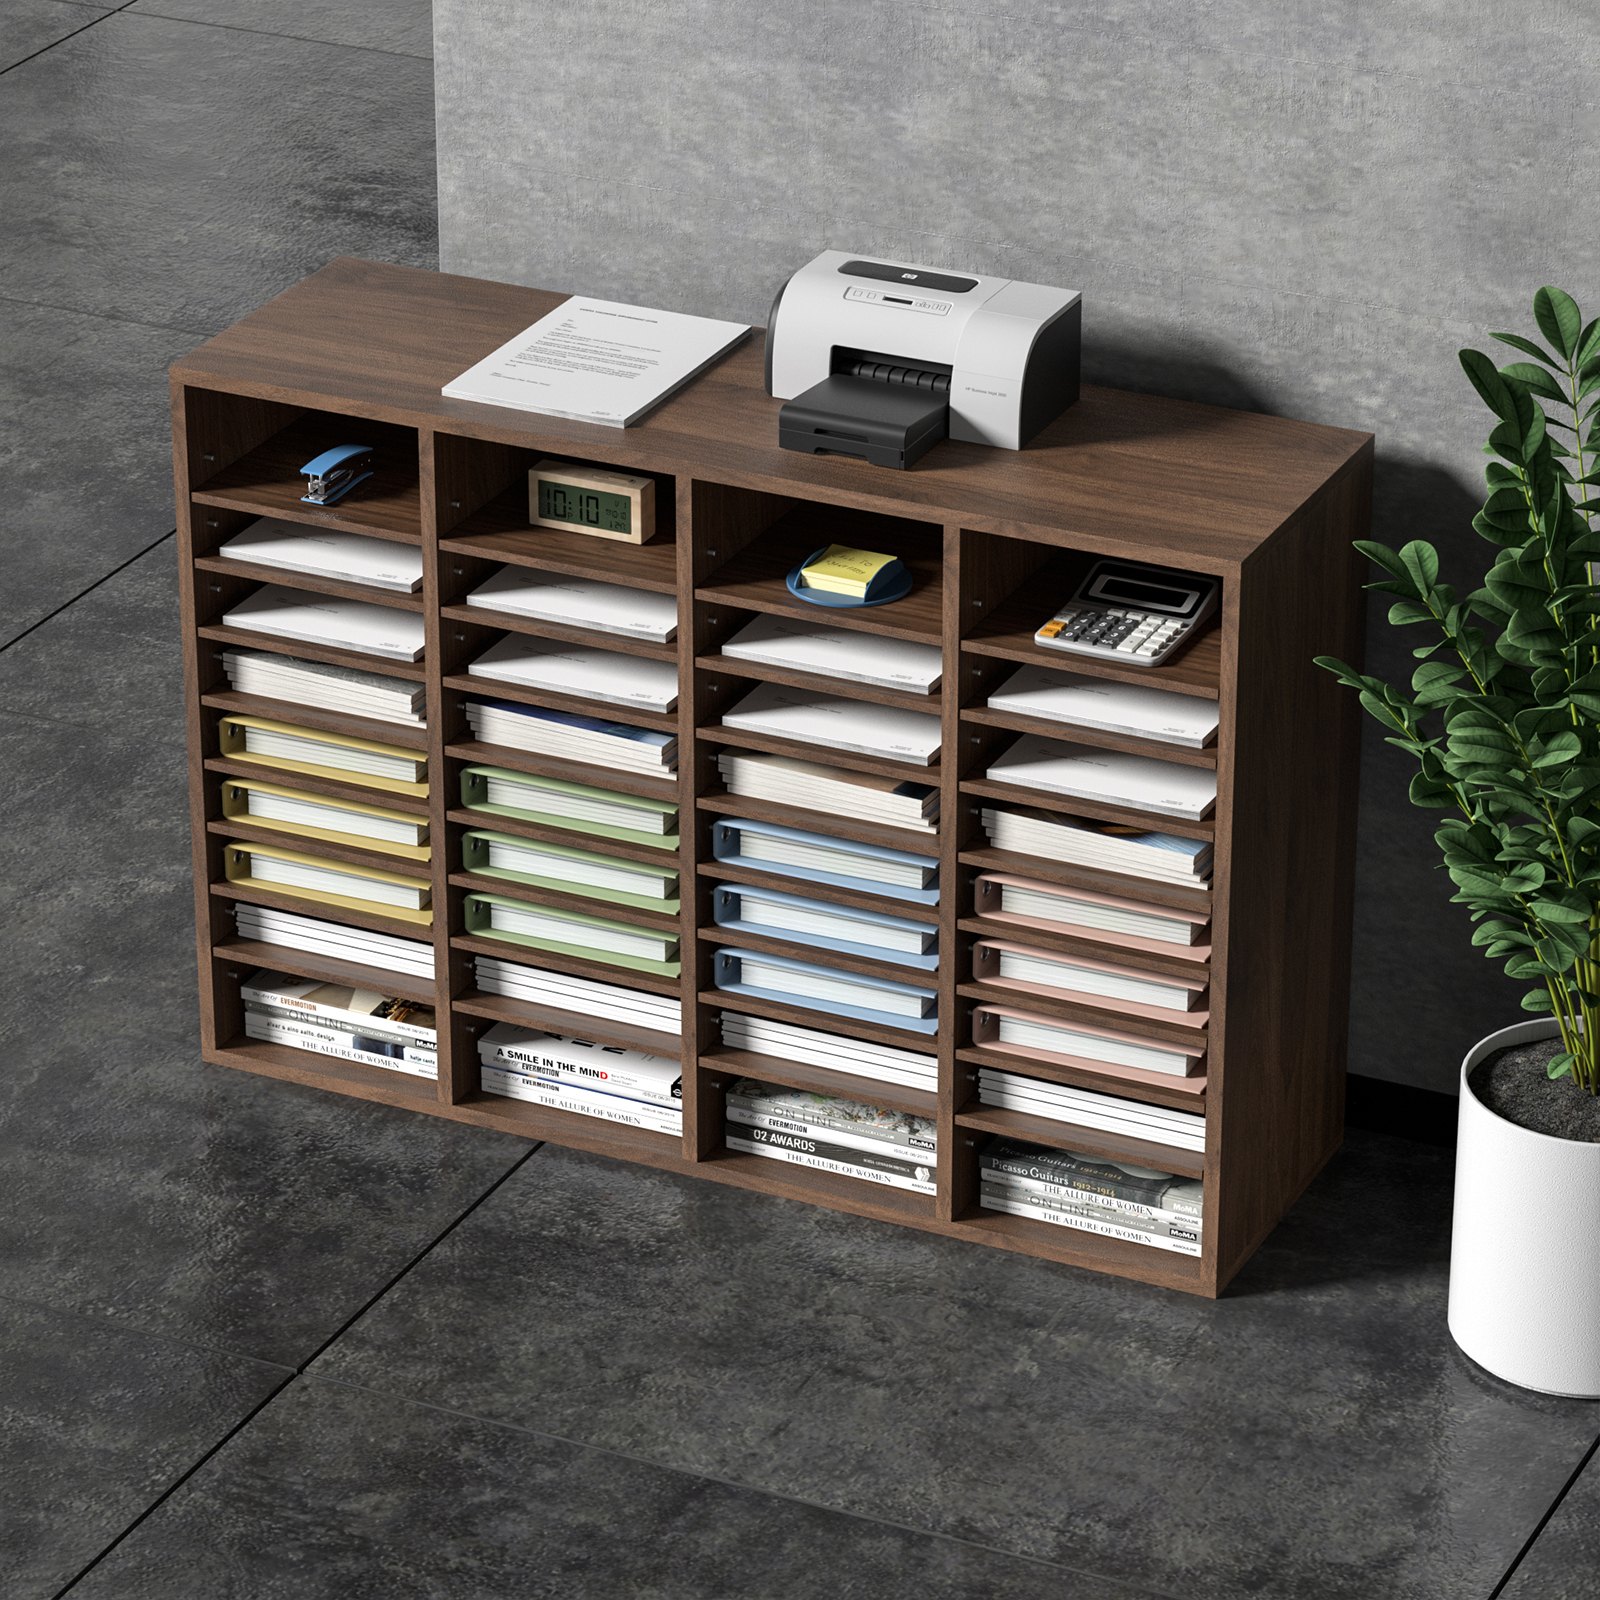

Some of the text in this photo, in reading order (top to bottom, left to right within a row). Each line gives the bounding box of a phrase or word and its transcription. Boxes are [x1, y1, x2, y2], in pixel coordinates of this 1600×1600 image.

[547, 488, 599, 525] 10:10
[280, 997, 317, 1011] EVERMOTION
[288, 1009, 309, 1022] ON
[316, 1015, 349, 1032] LINE
[316, 1033, 335, 1042] design
[302, 1041, 400, 1068] THE ALLURE OF WOMEN
[497, 1048, 504, 1057] A
[507, 1050, 539, 1064] SMILE
[543, 1059, 553, 1068] IN
[557, 1061, 576, 1073] THE
[579, 1067, 608, 1080] MIND
[521, 1063, 560, 1078] EVERMOTION
[522, 1078, 560, 1092] EVERMOTION
[540, 1095, 641, 1125] THE ALLURE OF WOMEN
[774, 1106, 795, 1119] ON
[803, 1110, 837, 1127] LINE
[768, 1118, 808, 1133] EVERMOTION
[769, 1133, 816, 1152] AWARDS
[909, 1138, 934, 1150] MoMA
[786, 1152, 804, 1163] THE
[806, 1157, 841, 1171] ALLURE
[842, 1164, 855, 1173] OF
[856, 1168, 891, 1183] WOMEN
[992, 1158, 1028, 1176] Picasso
[1029, 1167, 1069, 1185] Guitars
[1038, 1155, 1077, 1169] Guitars
[1029, 1195, 1052, 1208] ON
[1060, 1202, 1095, 1218] LINE
[1043, 1184, 1062, 1195] THE
[1063, 1189, 1100, 1203] ALLURE
[1102, 1198, 1114, 1207] OF
[1116, 1201, 1153, 1216] WOMEN
[1173, 1203, 1198, 1215] MoMA
[1042, 1212, 1061, 1222] THE
[1063, 1217, 1099, 1231] ALLURE
[1101, 1225, 1113, 1234] OF
[1115, 1229, 1152, 1243] WOMEN
[1171, 1229, 1196, 1240] MoMA
